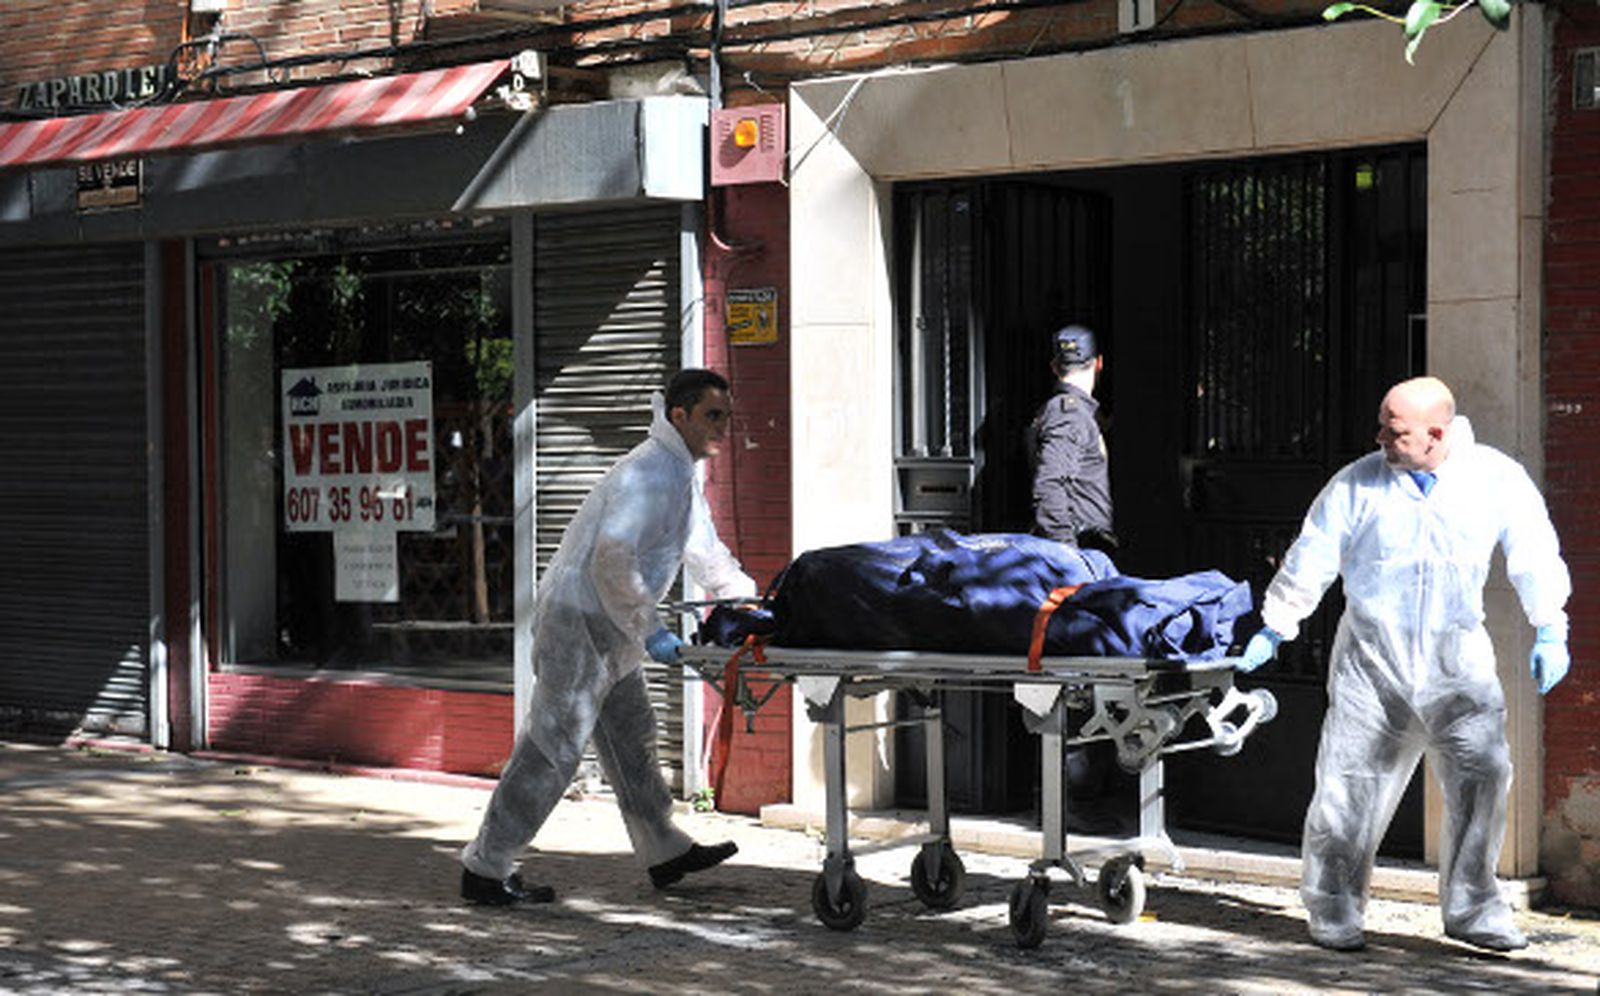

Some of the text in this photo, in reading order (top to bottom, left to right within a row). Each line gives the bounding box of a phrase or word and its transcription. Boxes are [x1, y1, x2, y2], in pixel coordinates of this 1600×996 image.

[289, 419, 430, 476] VENDE
[287, 486, 320, 523] 607
[328, 486, 352, 523] 35
